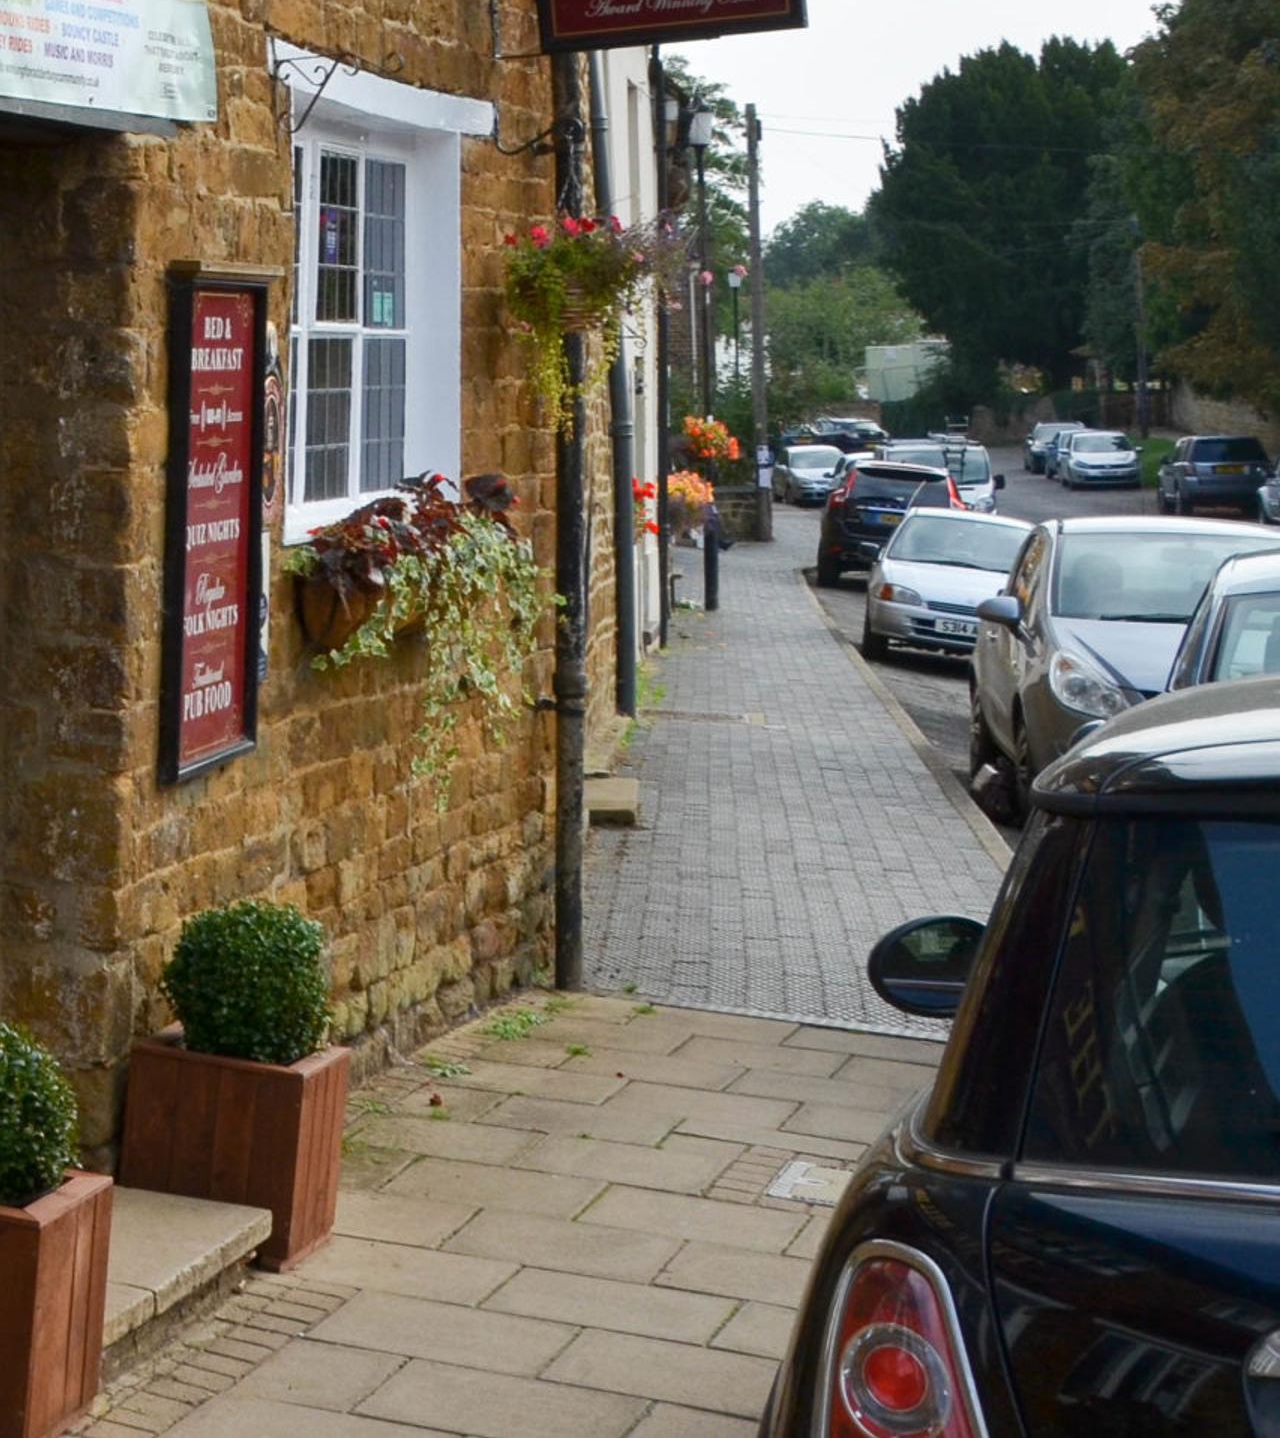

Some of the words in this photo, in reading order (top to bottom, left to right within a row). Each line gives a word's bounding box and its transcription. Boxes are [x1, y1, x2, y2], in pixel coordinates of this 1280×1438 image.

[44, 41, 69, 61] MUSIC
[70, 46, 86, 64] AND
[203, 315, 224, 339] BED
[224, 316, 233, 339] &
[190, 347, 245, 372] BREAKFAST
[185, 521, 206, 551] QUIZ
[207, 517, 240, 543] NIGHTS
[206, 603, 239, 632] NIGHTS
[183, 688, 204, 723] PUB
[204, 680, 233, 715] FOOD
